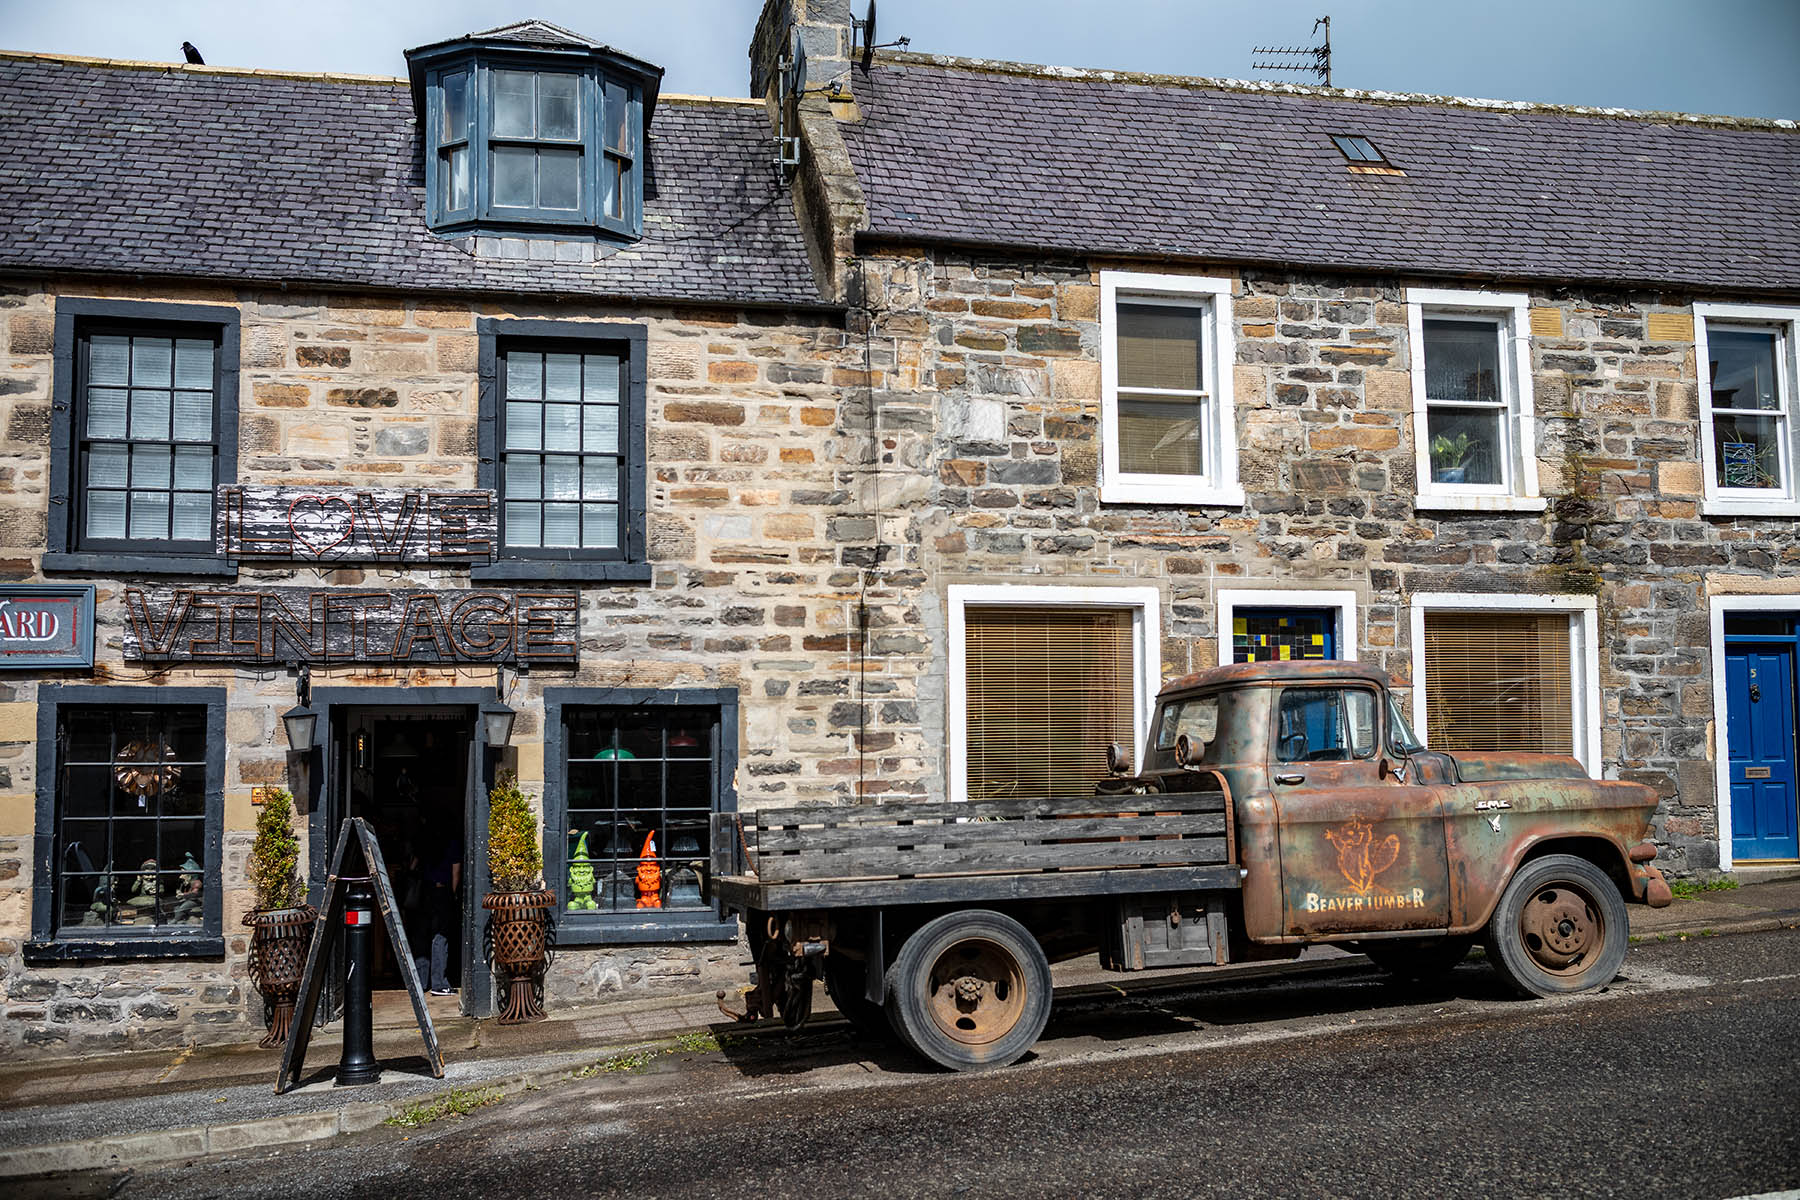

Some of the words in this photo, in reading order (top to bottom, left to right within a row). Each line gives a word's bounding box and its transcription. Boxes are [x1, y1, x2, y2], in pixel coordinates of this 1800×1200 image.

[0, 600, 59, 642] ARD
[124, 588, 578, 658] VINTAGE
[1750, 668, 1757, 679] 5
[1475, 800, 1512, 810] GMC
[1306, 892, 1363, 913] BEAVER
